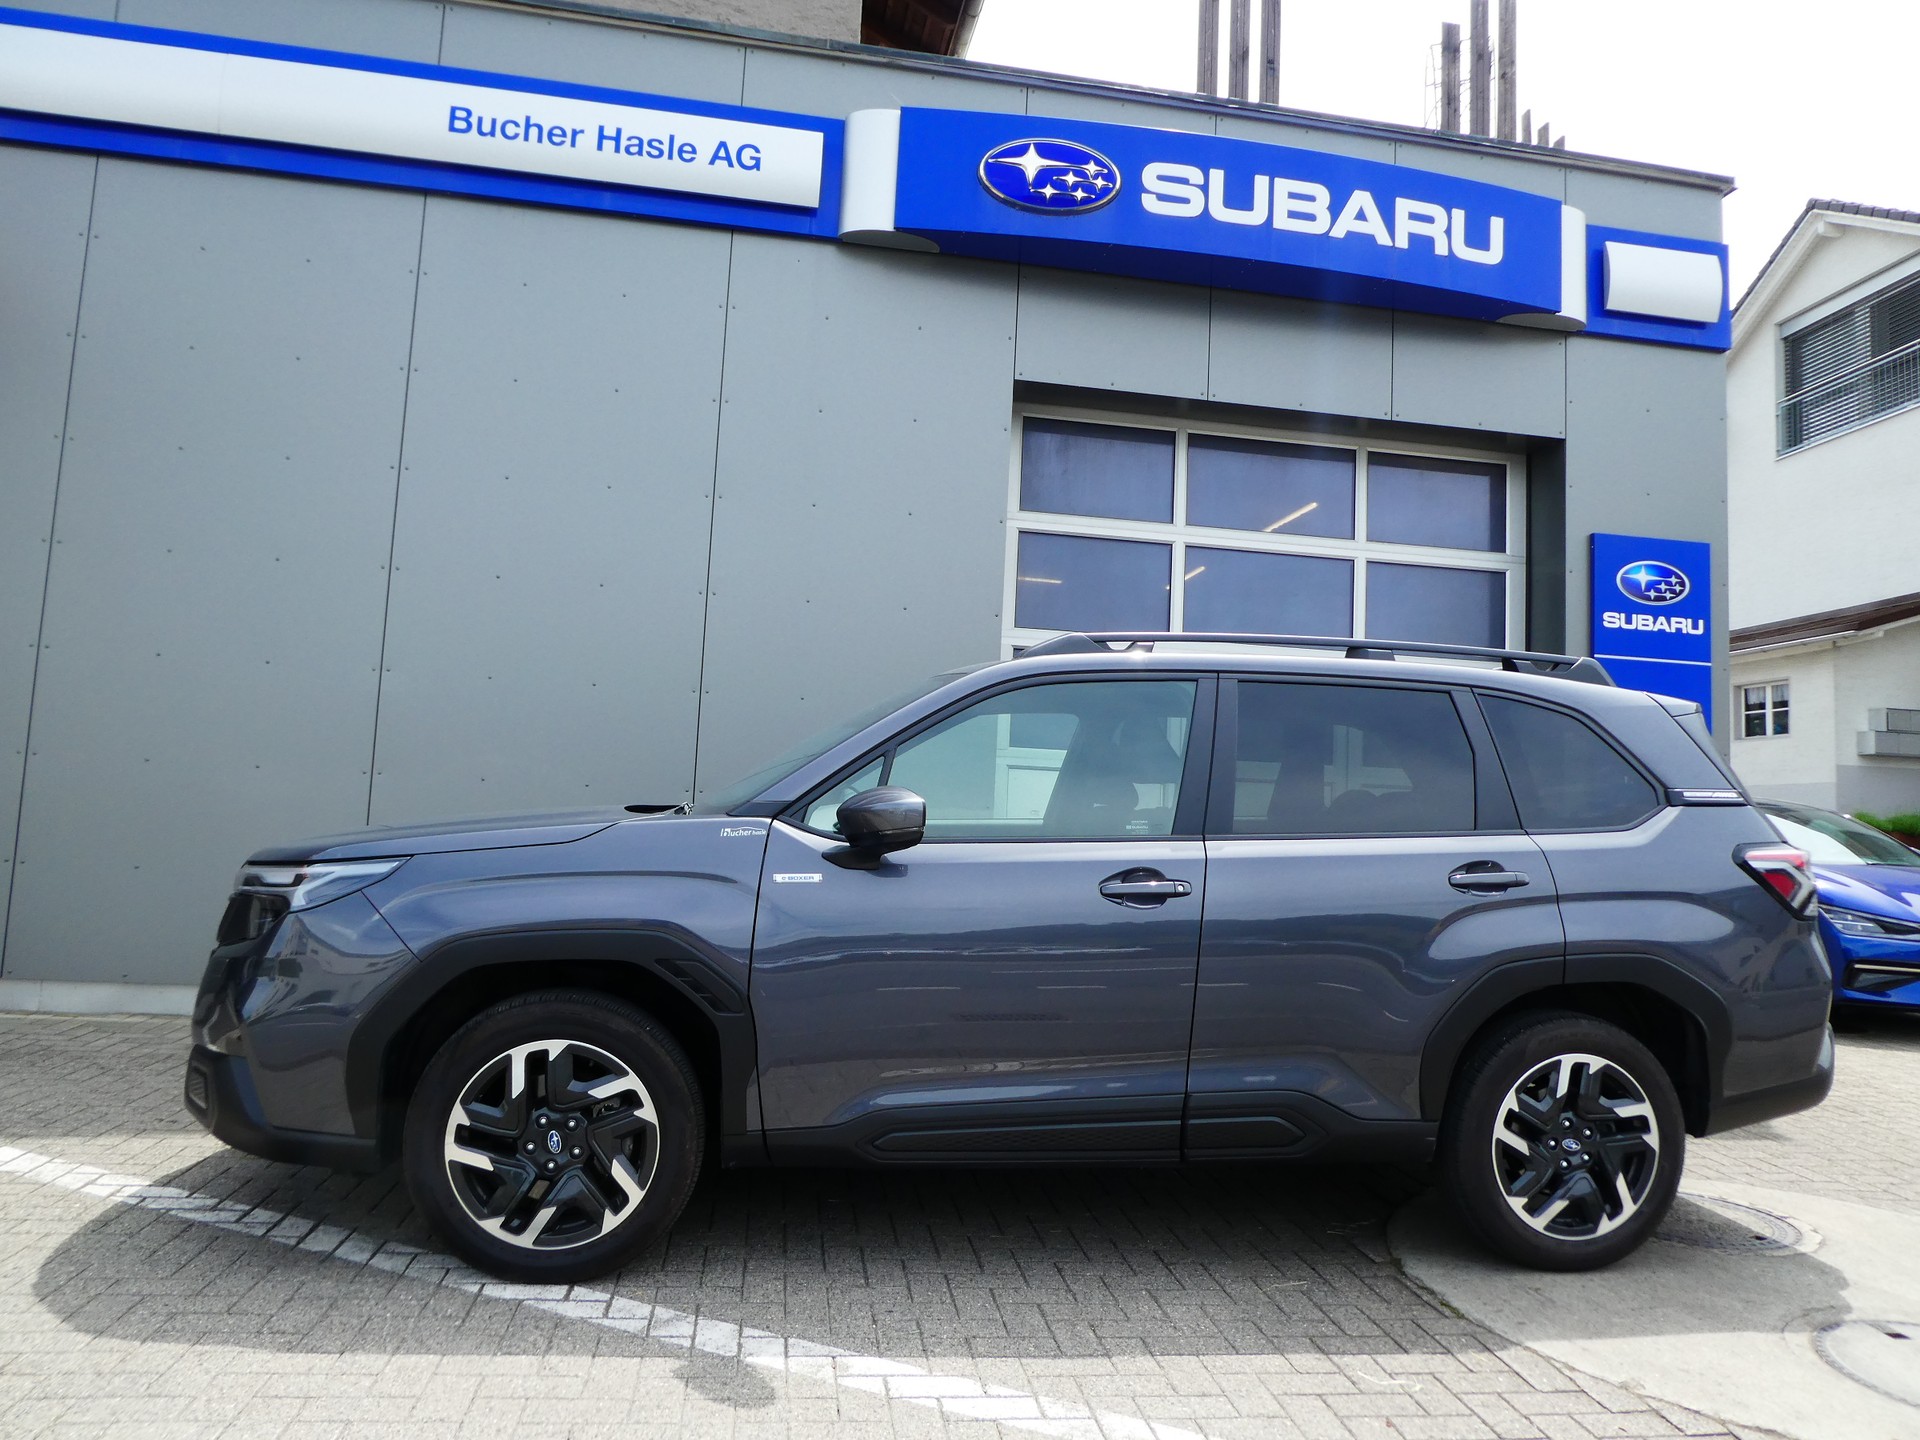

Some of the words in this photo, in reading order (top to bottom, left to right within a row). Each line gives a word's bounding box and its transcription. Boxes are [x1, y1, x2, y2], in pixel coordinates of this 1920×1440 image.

[448, 105, 585, 149] Bucher
[596, 124, 698, 164] Hasle
[708, 140, 762, 172] AG
[1141, 161, 1505, 265] SUBARU
[1602, 611, 1704, 635] SUBARU
